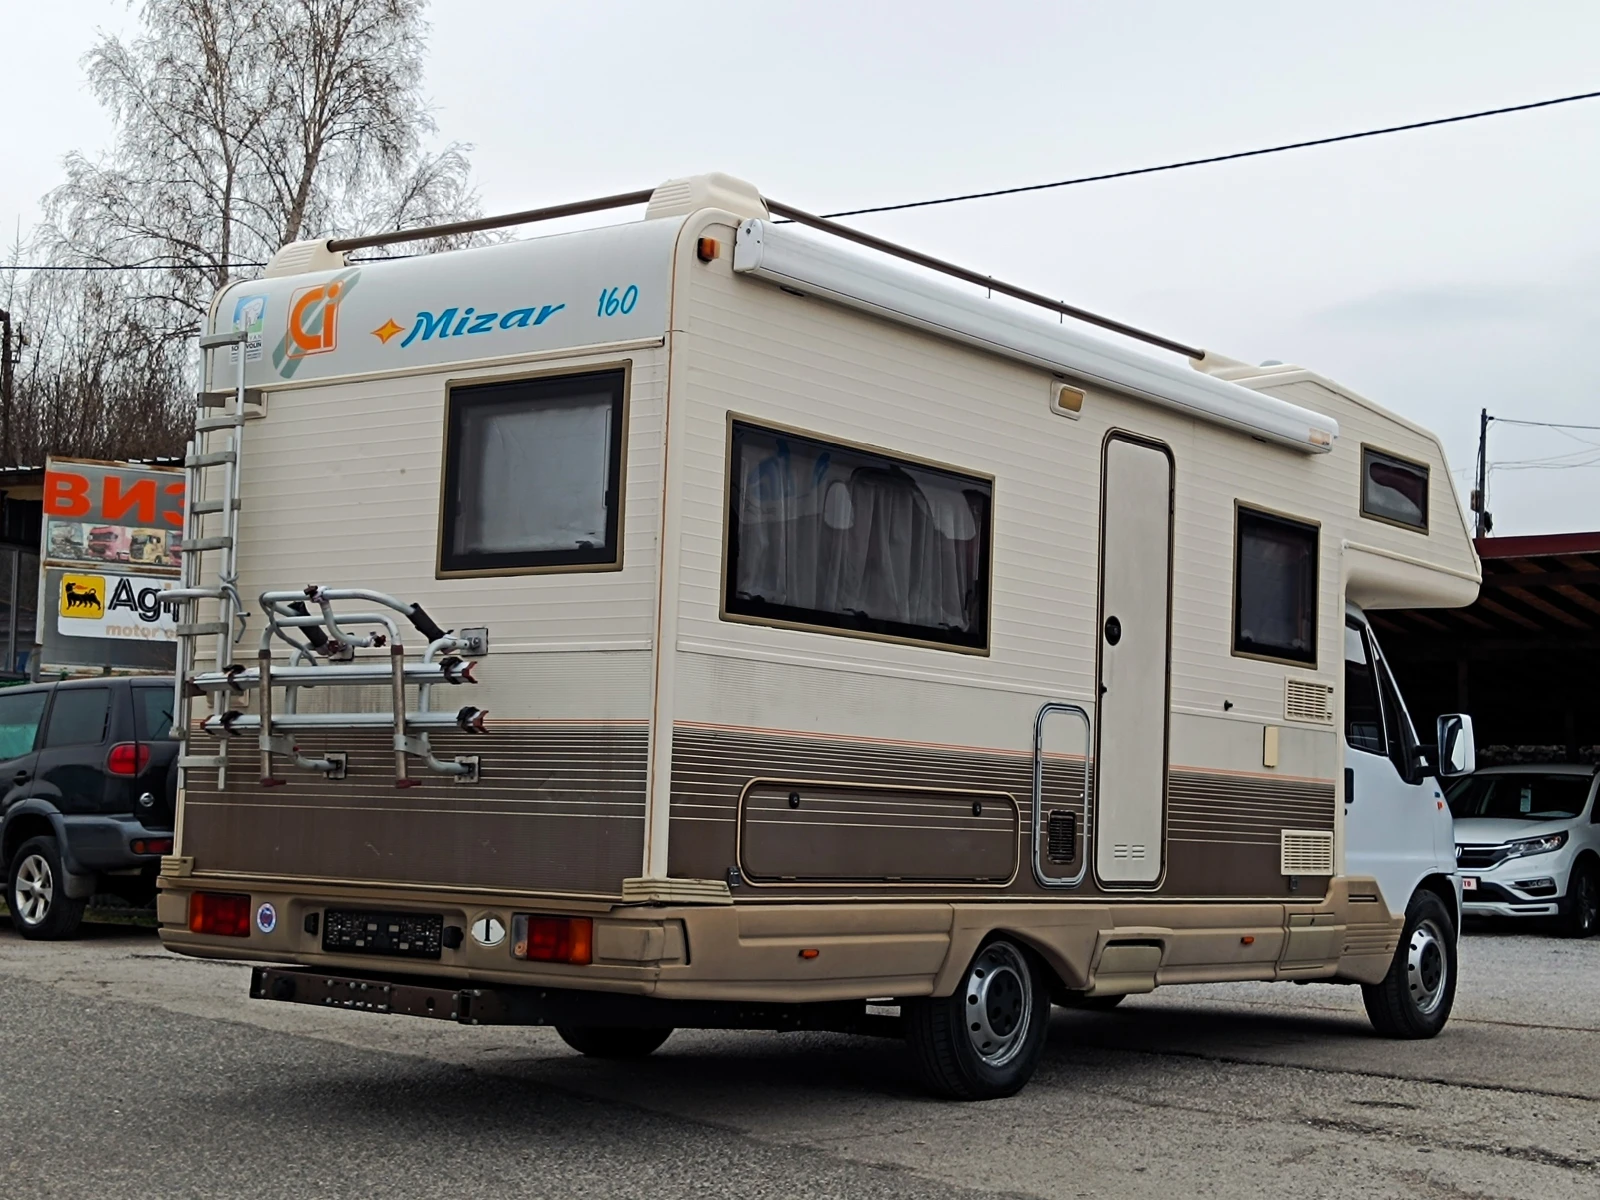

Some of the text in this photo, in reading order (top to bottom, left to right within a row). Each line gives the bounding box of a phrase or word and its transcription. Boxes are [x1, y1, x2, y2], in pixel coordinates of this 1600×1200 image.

[400, 284, 640, 349] Mizar 160
[105, 624, 160, 638] motor
